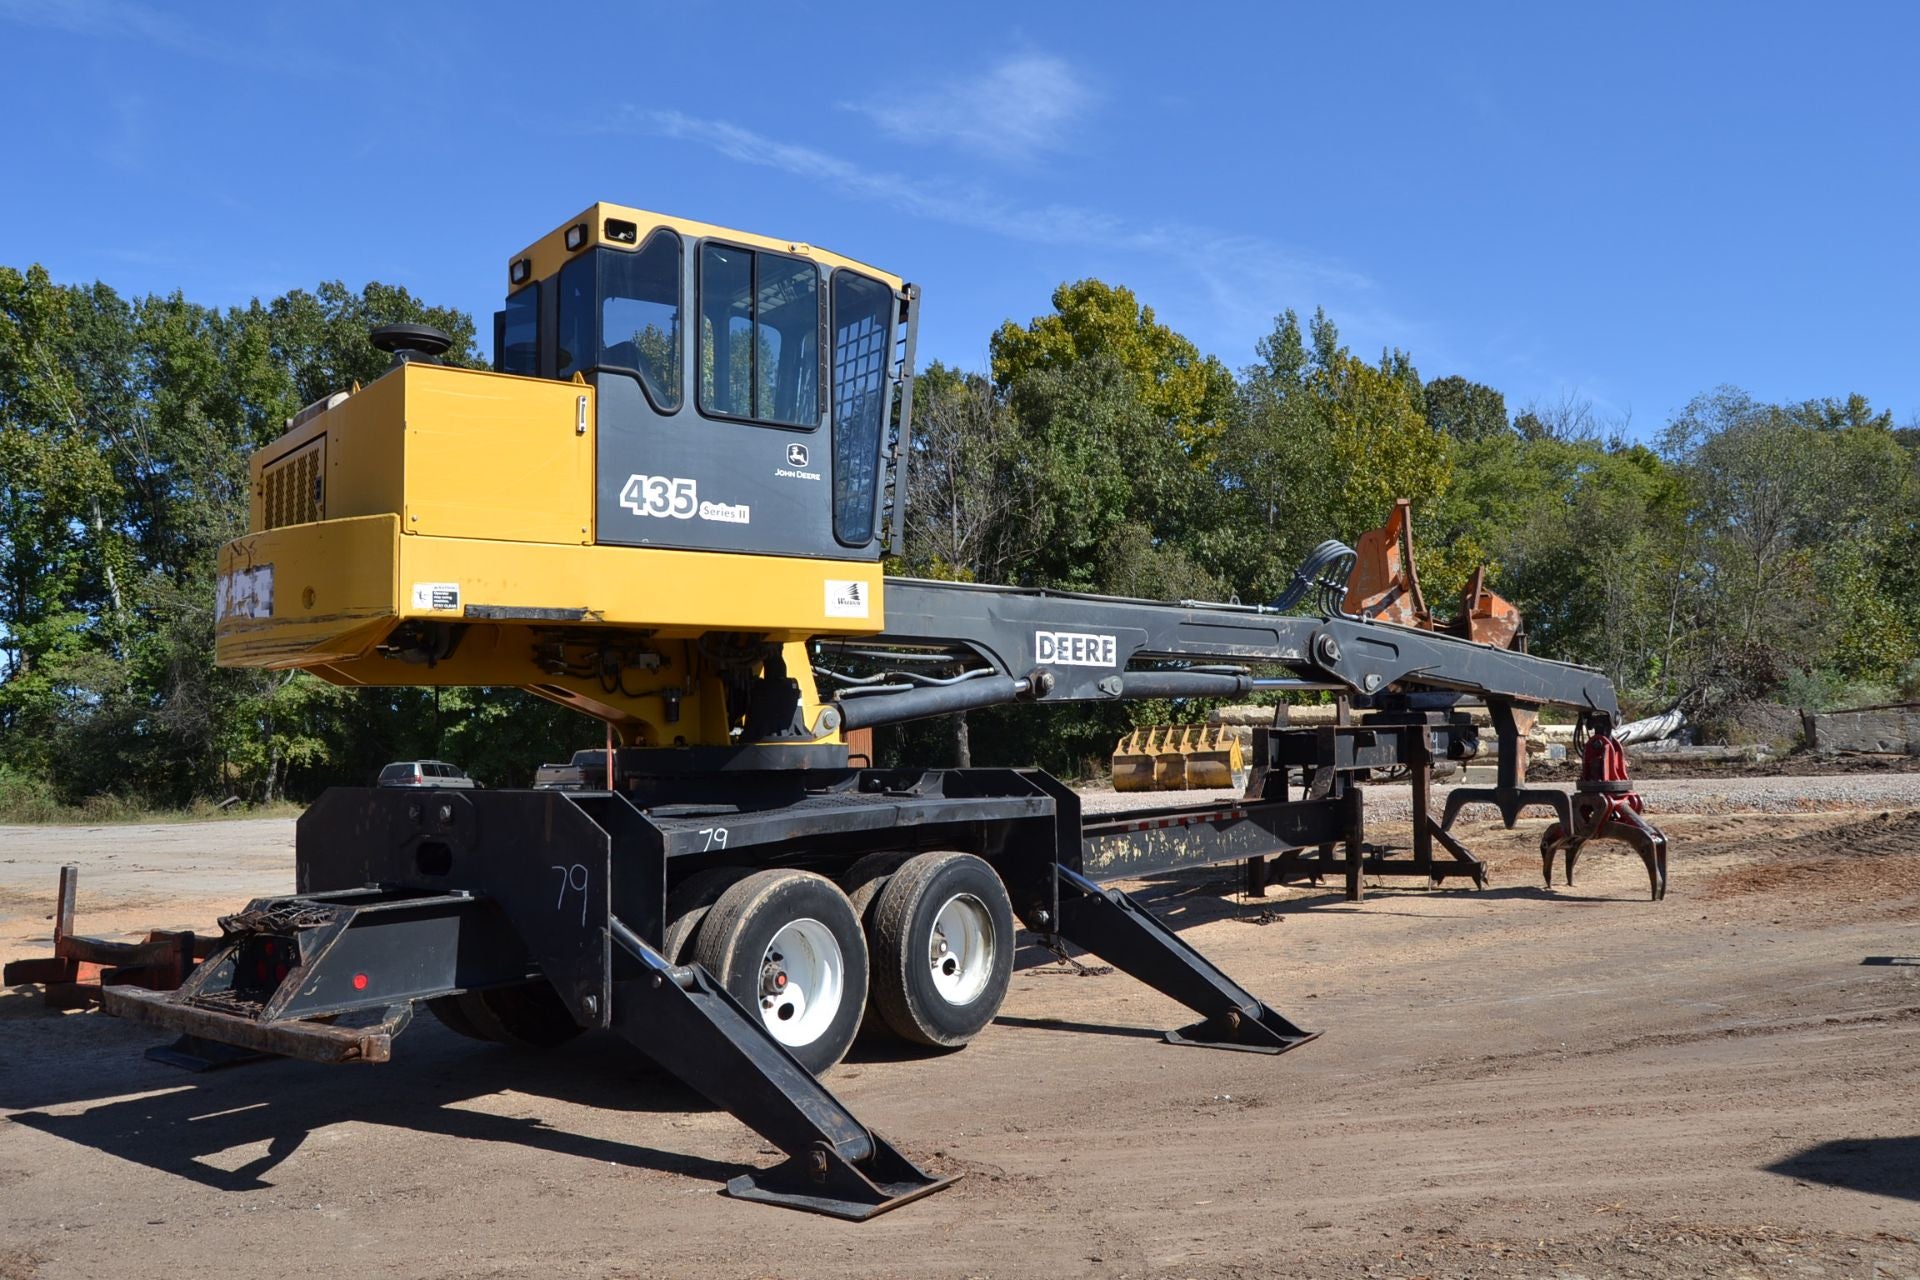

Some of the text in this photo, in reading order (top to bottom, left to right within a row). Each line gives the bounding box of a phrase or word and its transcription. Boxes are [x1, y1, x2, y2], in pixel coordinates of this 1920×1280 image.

[774, 468, 821, 480] JOHN DEERE
[621, 475, 697, 518] 435
[702, 505, 736, 519] Series
[1038, 633, 1114, 665] DEERE
[699, 828, 728, 852] 79
[552, 864, 588, 928] 79
